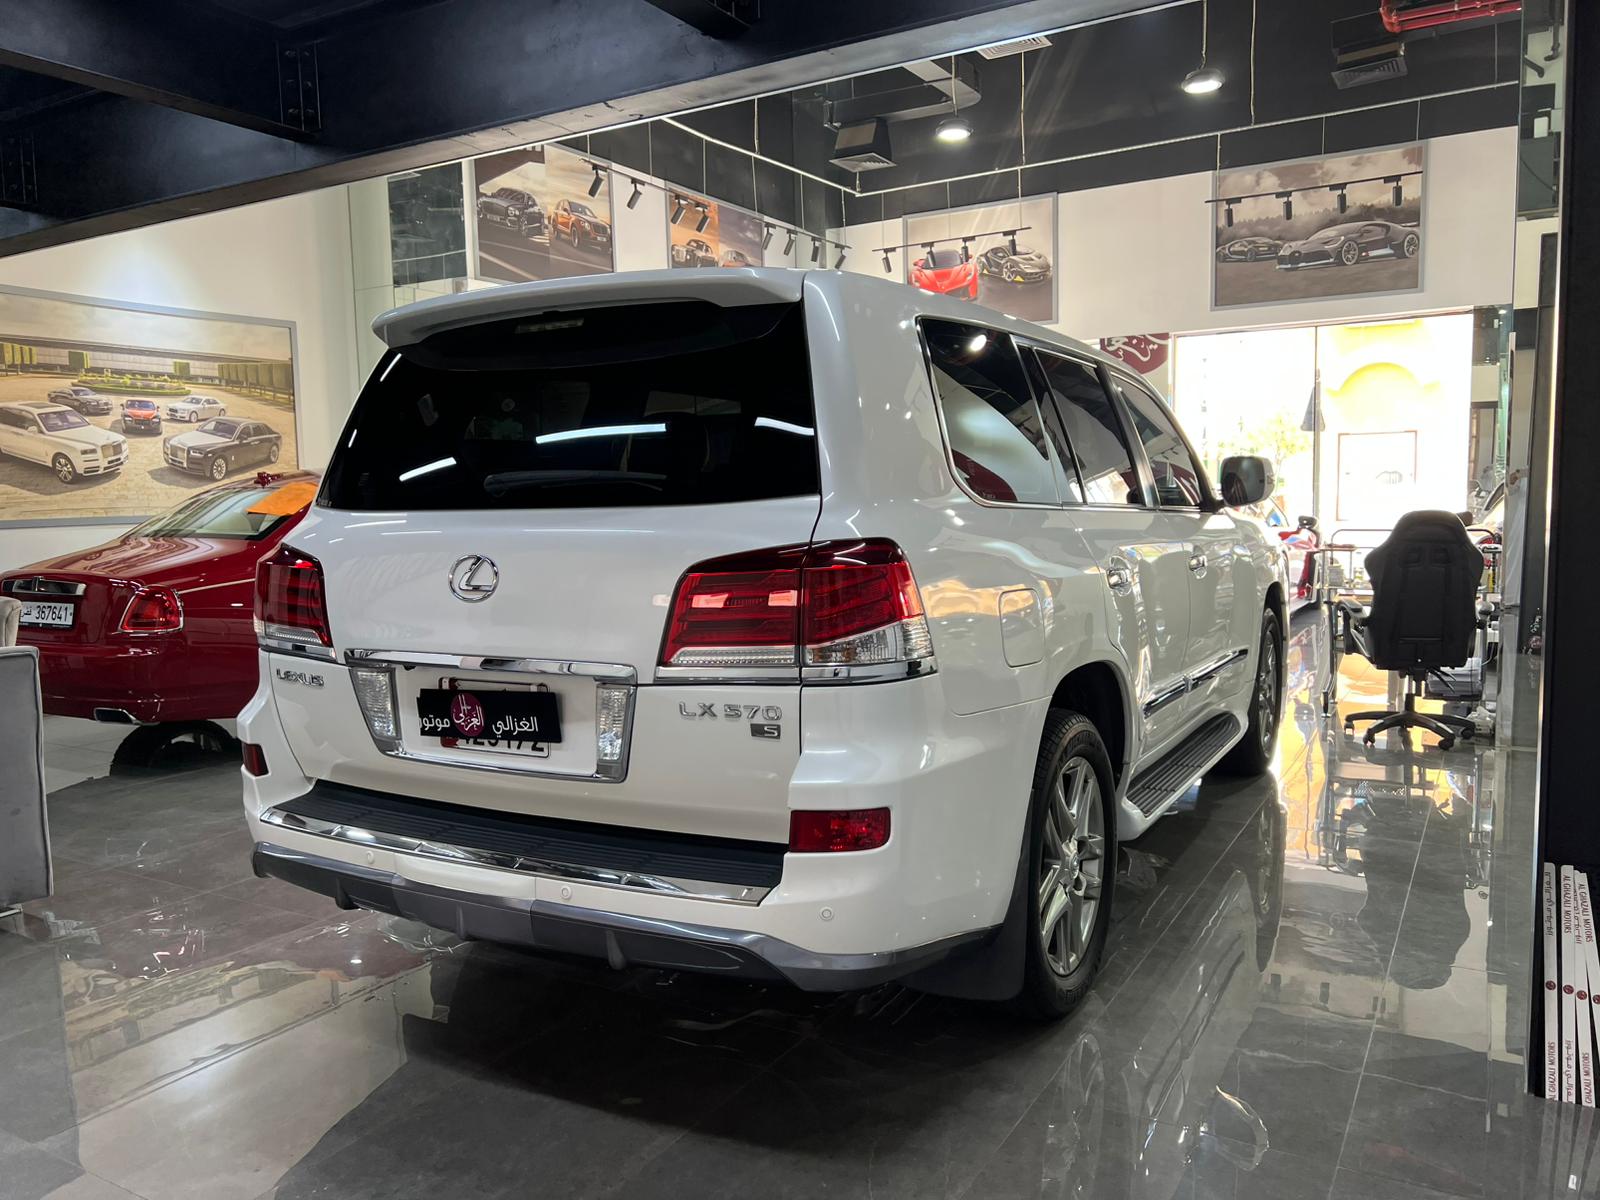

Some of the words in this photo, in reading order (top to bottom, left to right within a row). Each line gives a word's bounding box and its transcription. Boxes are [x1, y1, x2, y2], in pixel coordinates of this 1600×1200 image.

[36, 605, 68, 622] 367641
[276, 668, 325, 687] LEXUS
[679, 701, 718, 719] LX
[723, 703, 783, 721] 570
[492, 714, 539, 738] الغزالي
[763, 725, 779, 737] S
[1563, 883, 1571, 908] GHAZALI
[1580, 891, 1590, 917] GHAZALI
[1563, 910, 1572, 934] MOTORS
[1583, 918, 1594, 943] MOTORS
[1547, 1041, 1556, 1066] MOTORS
[1582, 1052, 1591, 1077] MOTORS
[1548, 1067, 1556, 1093] GHAZALI
[1584, 1078, 1593, 1104] GHAZALI
